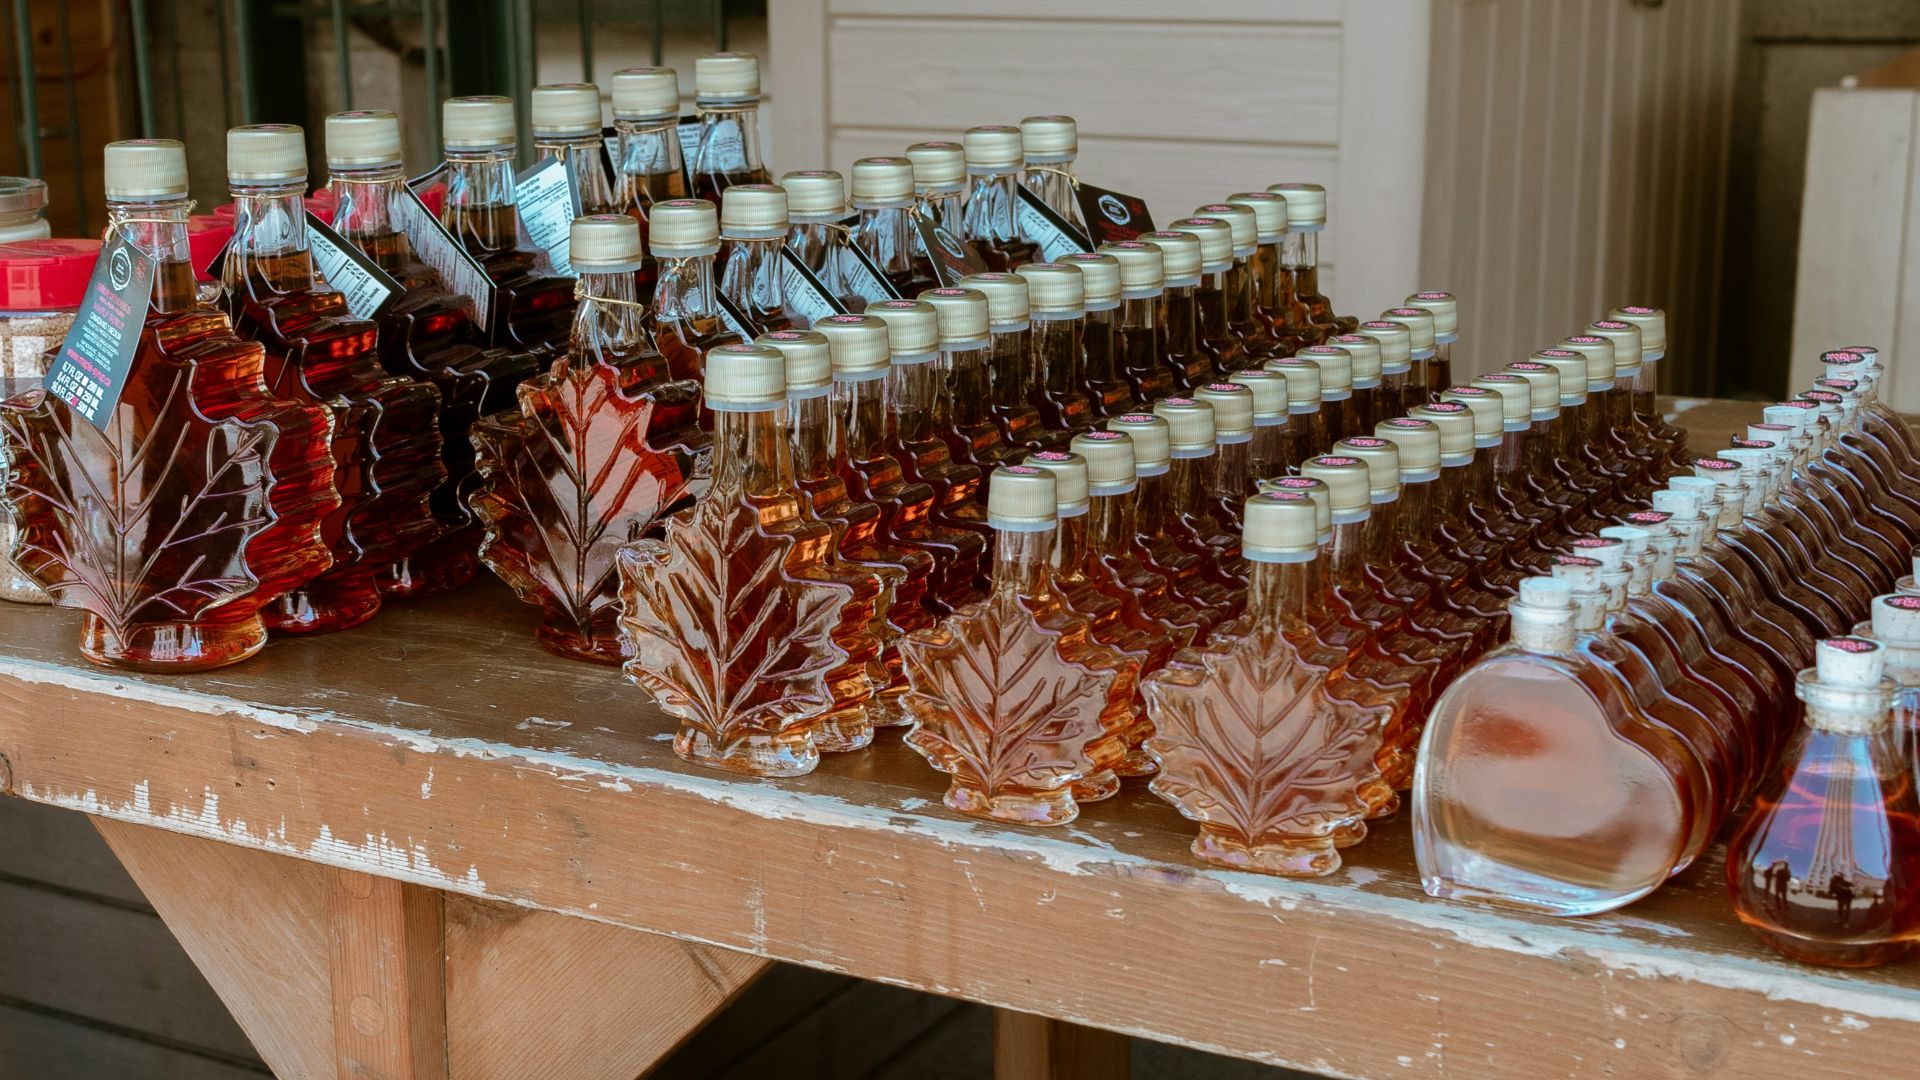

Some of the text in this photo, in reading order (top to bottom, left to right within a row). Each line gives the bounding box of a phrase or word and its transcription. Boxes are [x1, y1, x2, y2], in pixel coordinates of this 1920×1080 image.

[63, 376, 71, 388] FL
[69, 380, 79, 392] OZ
[81, 390, 93, 404] 250
[90, 397, 99, 410] ML
[68, 365, 76, 377] FL
[74, 370, 84, 382] OZ
[87, 380, 98, 393] 200
[95, 387, 104, 400] ML
[58, 387, 66, 398] FL
[76, 400, 88, 414] 500
[85, 407, 95, 421] ML
